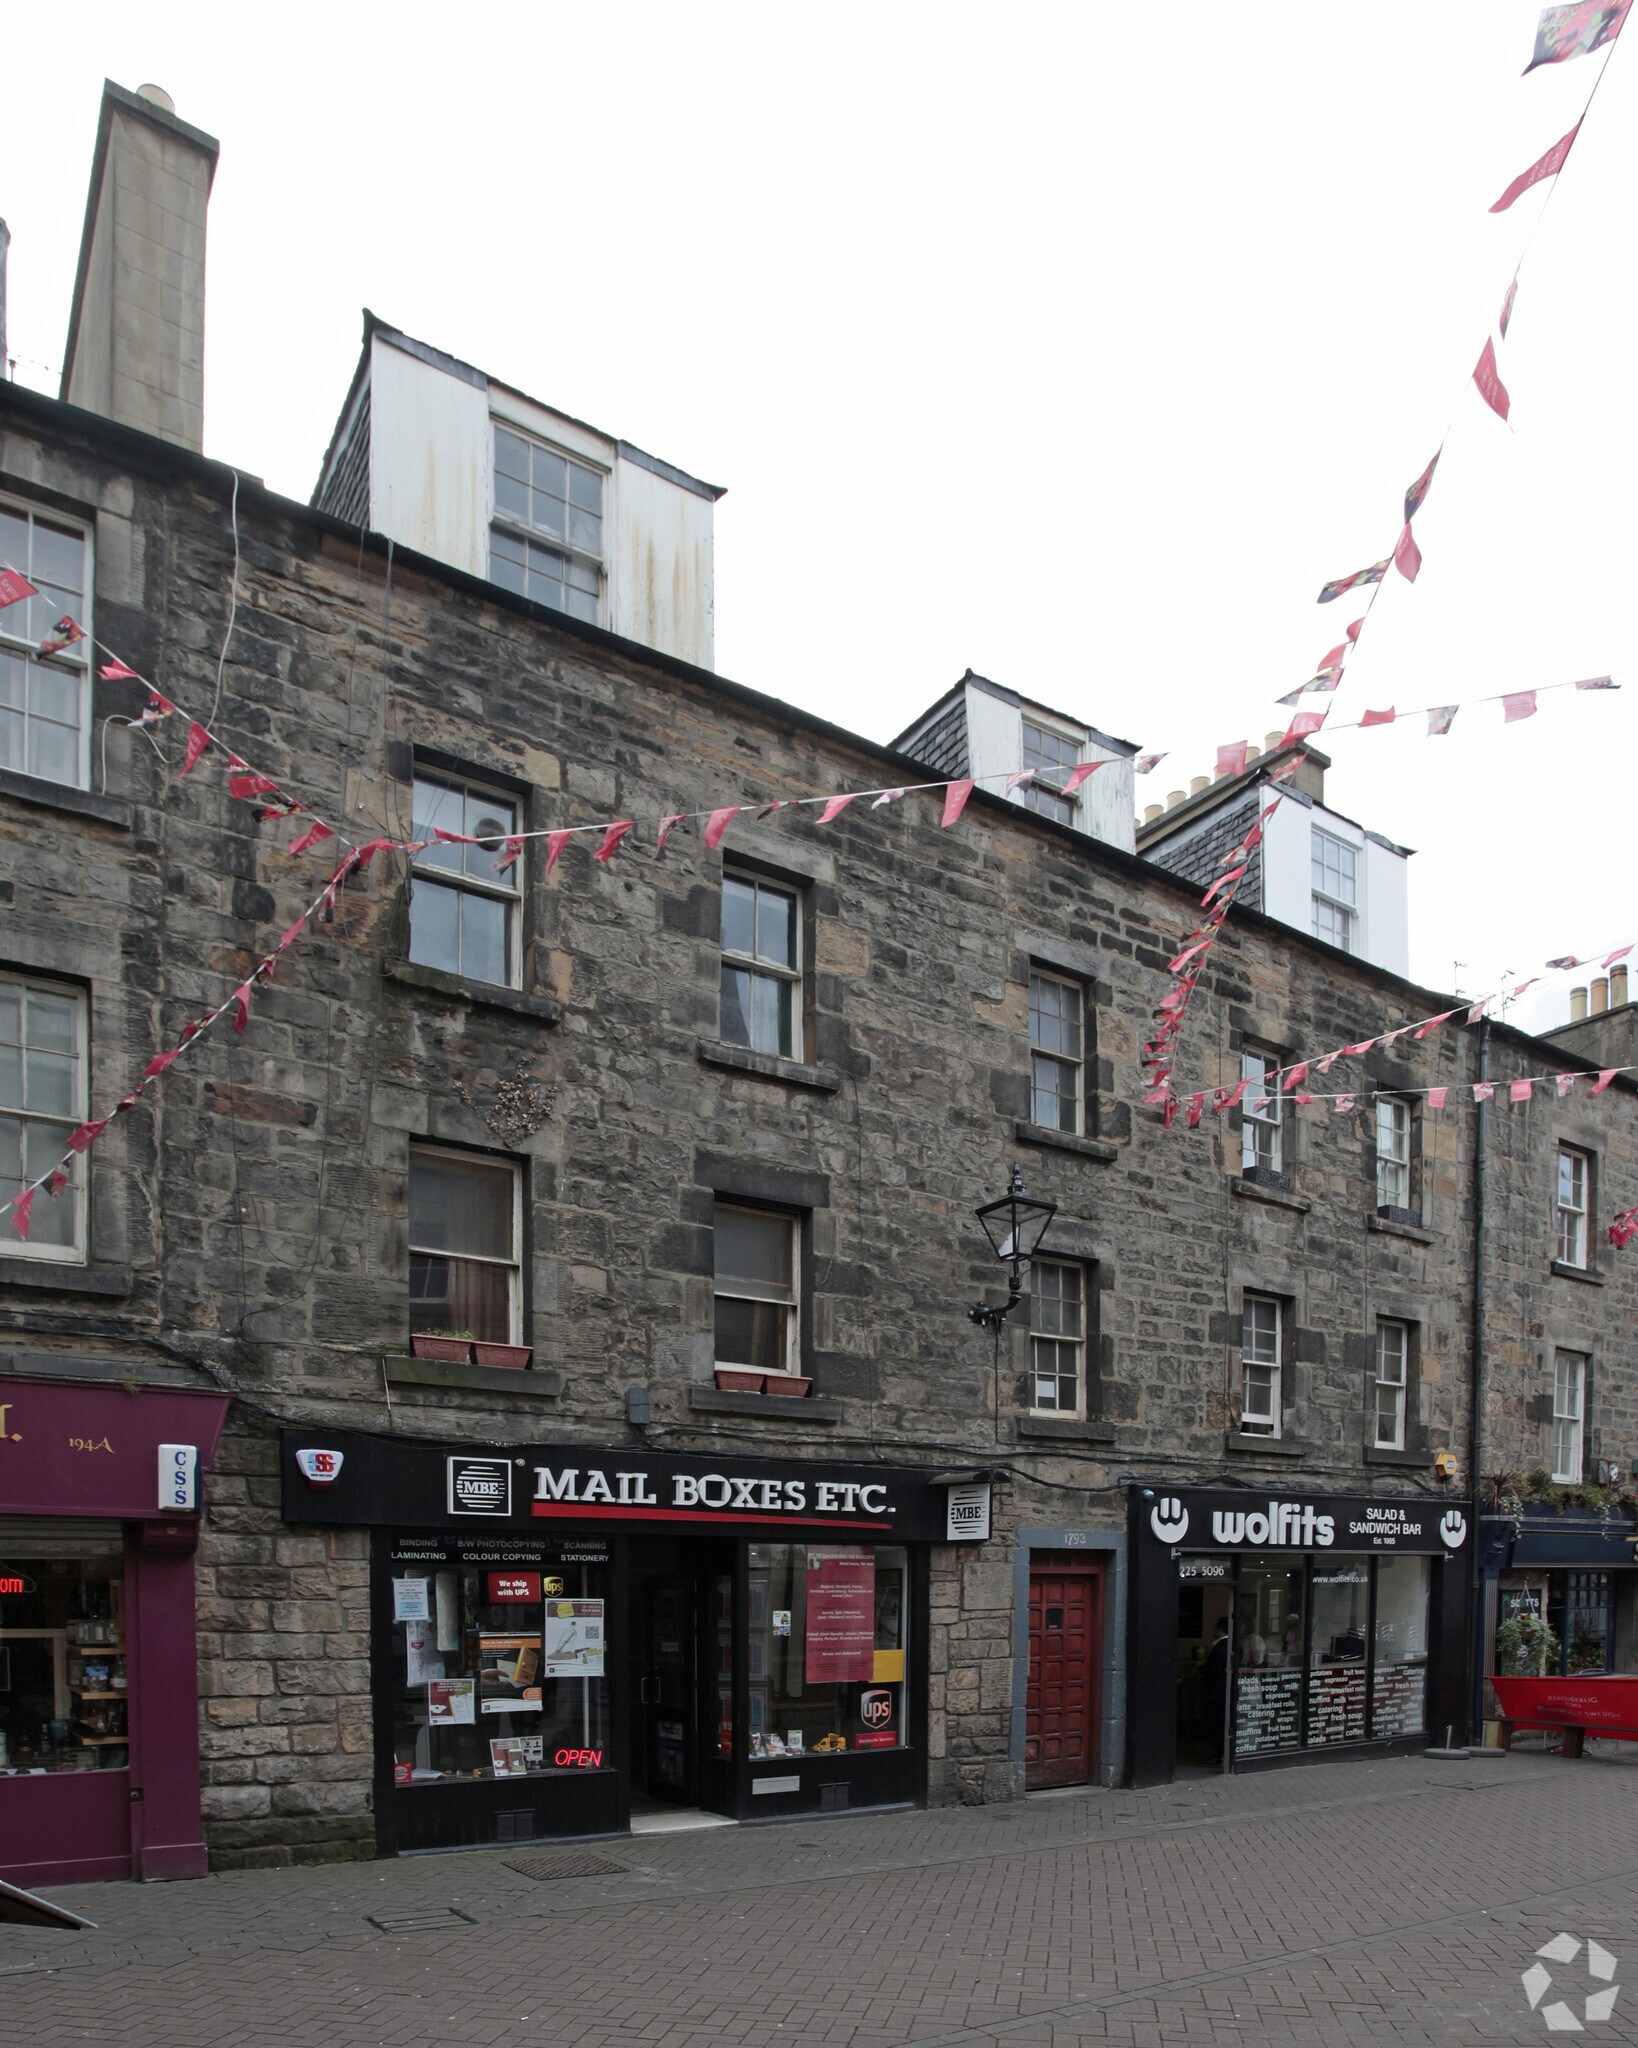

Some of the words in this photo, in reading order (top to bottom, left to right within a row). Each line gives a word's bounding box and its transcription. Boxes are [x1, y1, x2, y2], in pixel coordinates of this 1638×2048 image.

[68, 1436, 117, 1455] 194A
[463, 1481, 499, 1495] MBE
[533, 1467, 657, 1504] MAIL
[672, 1474, 807, 1511] BOXES
[815, 1482, 896, 1514] ETC.
[956, 1506, 981, 1520] MBE
[1366, 1508, 1398, 1521] SALAD
[1399, 1509, 1406, 1521] &
[1212, 1501, 1335, 1546] wolfits
[1349, 1522, 1400, 1534] SANDWICH
[1402, 1523, 1422, 1535] BAR
[400, 1538, 438, 1547] BINDING
[477, 1540, 545, 1548] PHOTOCOPYING
[564, 1542, 607, 1550] SCANNING
[391, 1552, 446, 1560] LAMINATING
[503, 1553, 541, 1561] COPYING
[560, 1554, 609, 1562] STATIONERY
[1179, 1566, 1197, 1576] 225
[1201, 1565, 1225, 1576] 5096
[1313, 1575, 1369, 1583] www.wolfits.co.uk
[546, 1583, 561, 1594] ups
[1282, 1672, 1301, 1681] paninis
[1242, 1685, 1259, 1693] fresh
[1285, 1682, 1299, 1690] milk
[864, 1701, 889, 1723] ups
[1248, 1710, 1275, 1718] catering
[1318, 1706, 1342, 1714] catering
[1236, 1728, 1262, 1736] muffins
[1345, 1728, 1364, 1737] coffee
[1255, 1735, 1279, 1743] potatoes
[1236, 1744, 1257, 1752] coffee
[555, 1749, 603, 1767] OPEN
